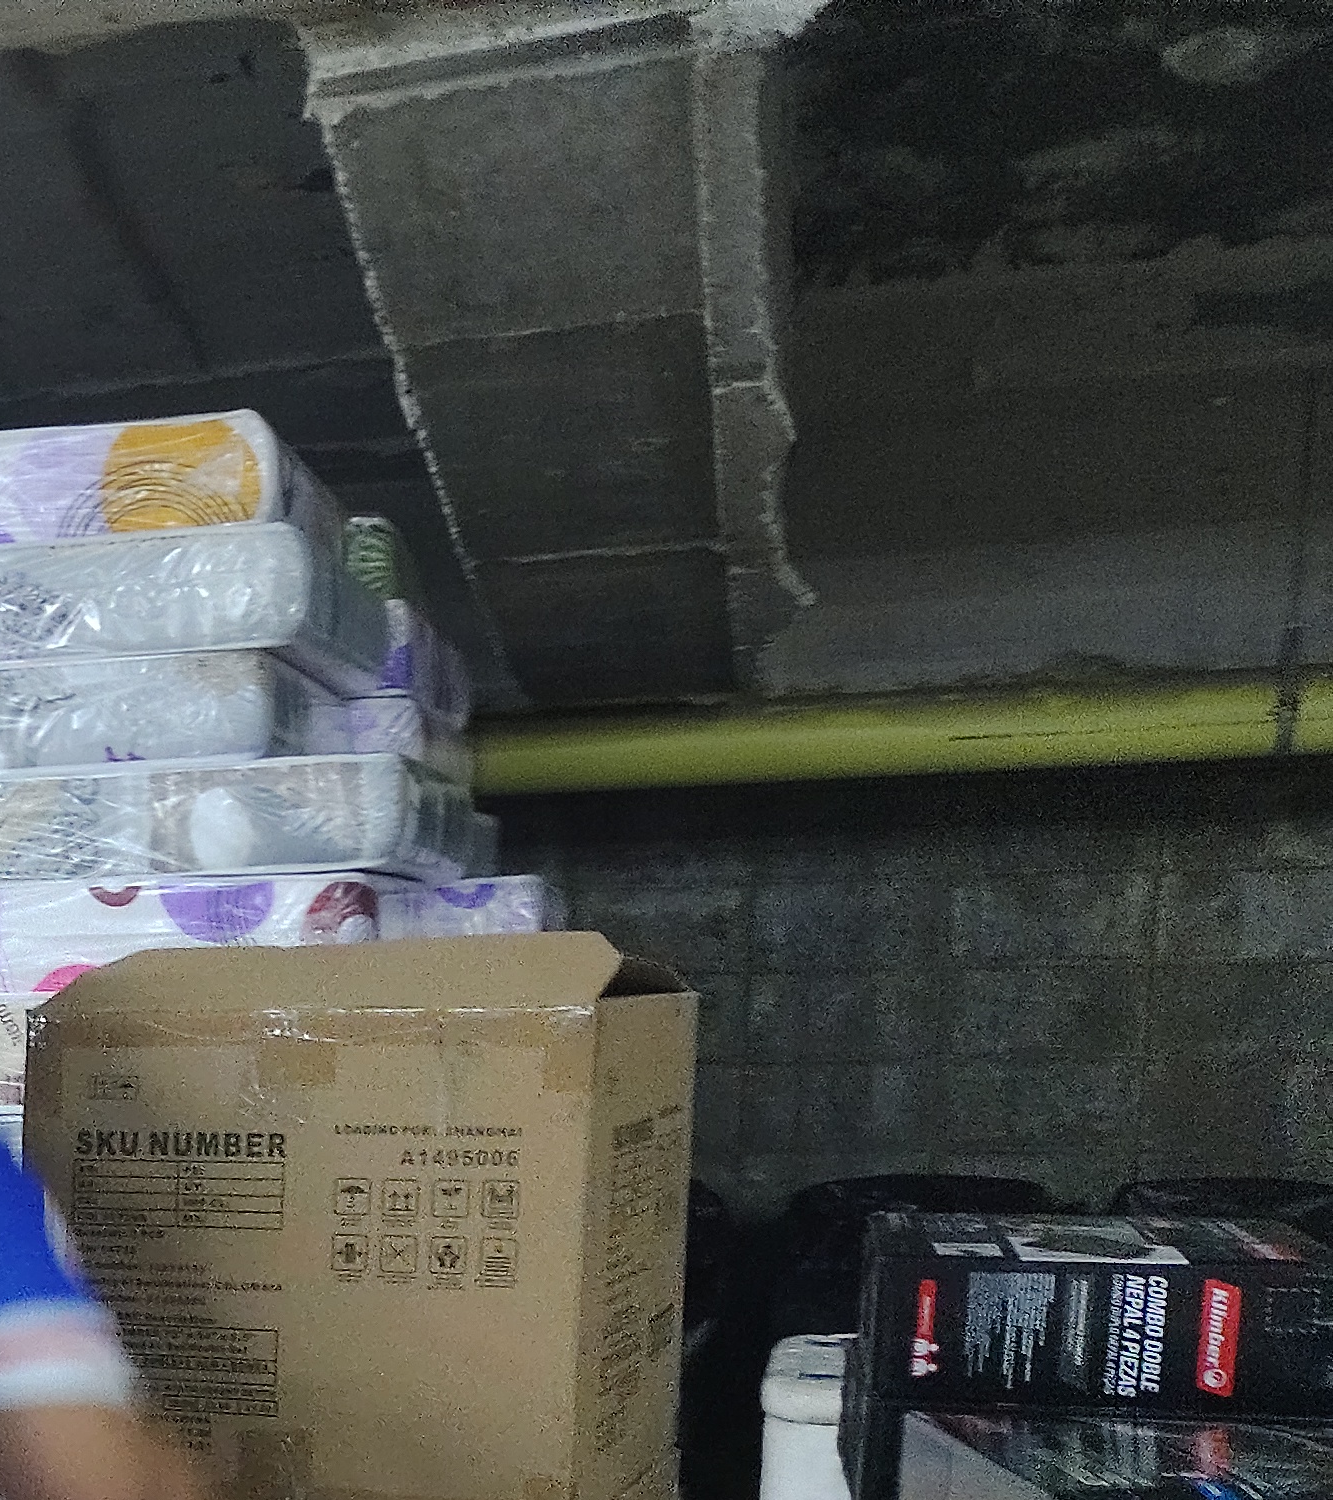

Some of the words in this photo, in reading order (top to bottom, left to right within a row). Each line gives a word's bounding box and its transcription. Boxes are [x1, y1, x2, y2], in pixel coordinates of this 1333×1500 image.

[76, 1128, 139, 1157] SKU
[149, 1131, 286, 1158] NUMBER
[1123, 1274, 1146, 1327] NEPAL
[1145, 1275, 1169, 1337] COMBO
[1205, 1288, 1229, 1368] Klimber
[1117, 1339, 1141, 1398] PIEZAS
[1140, 1338, 1163, 1393] DOBLE
